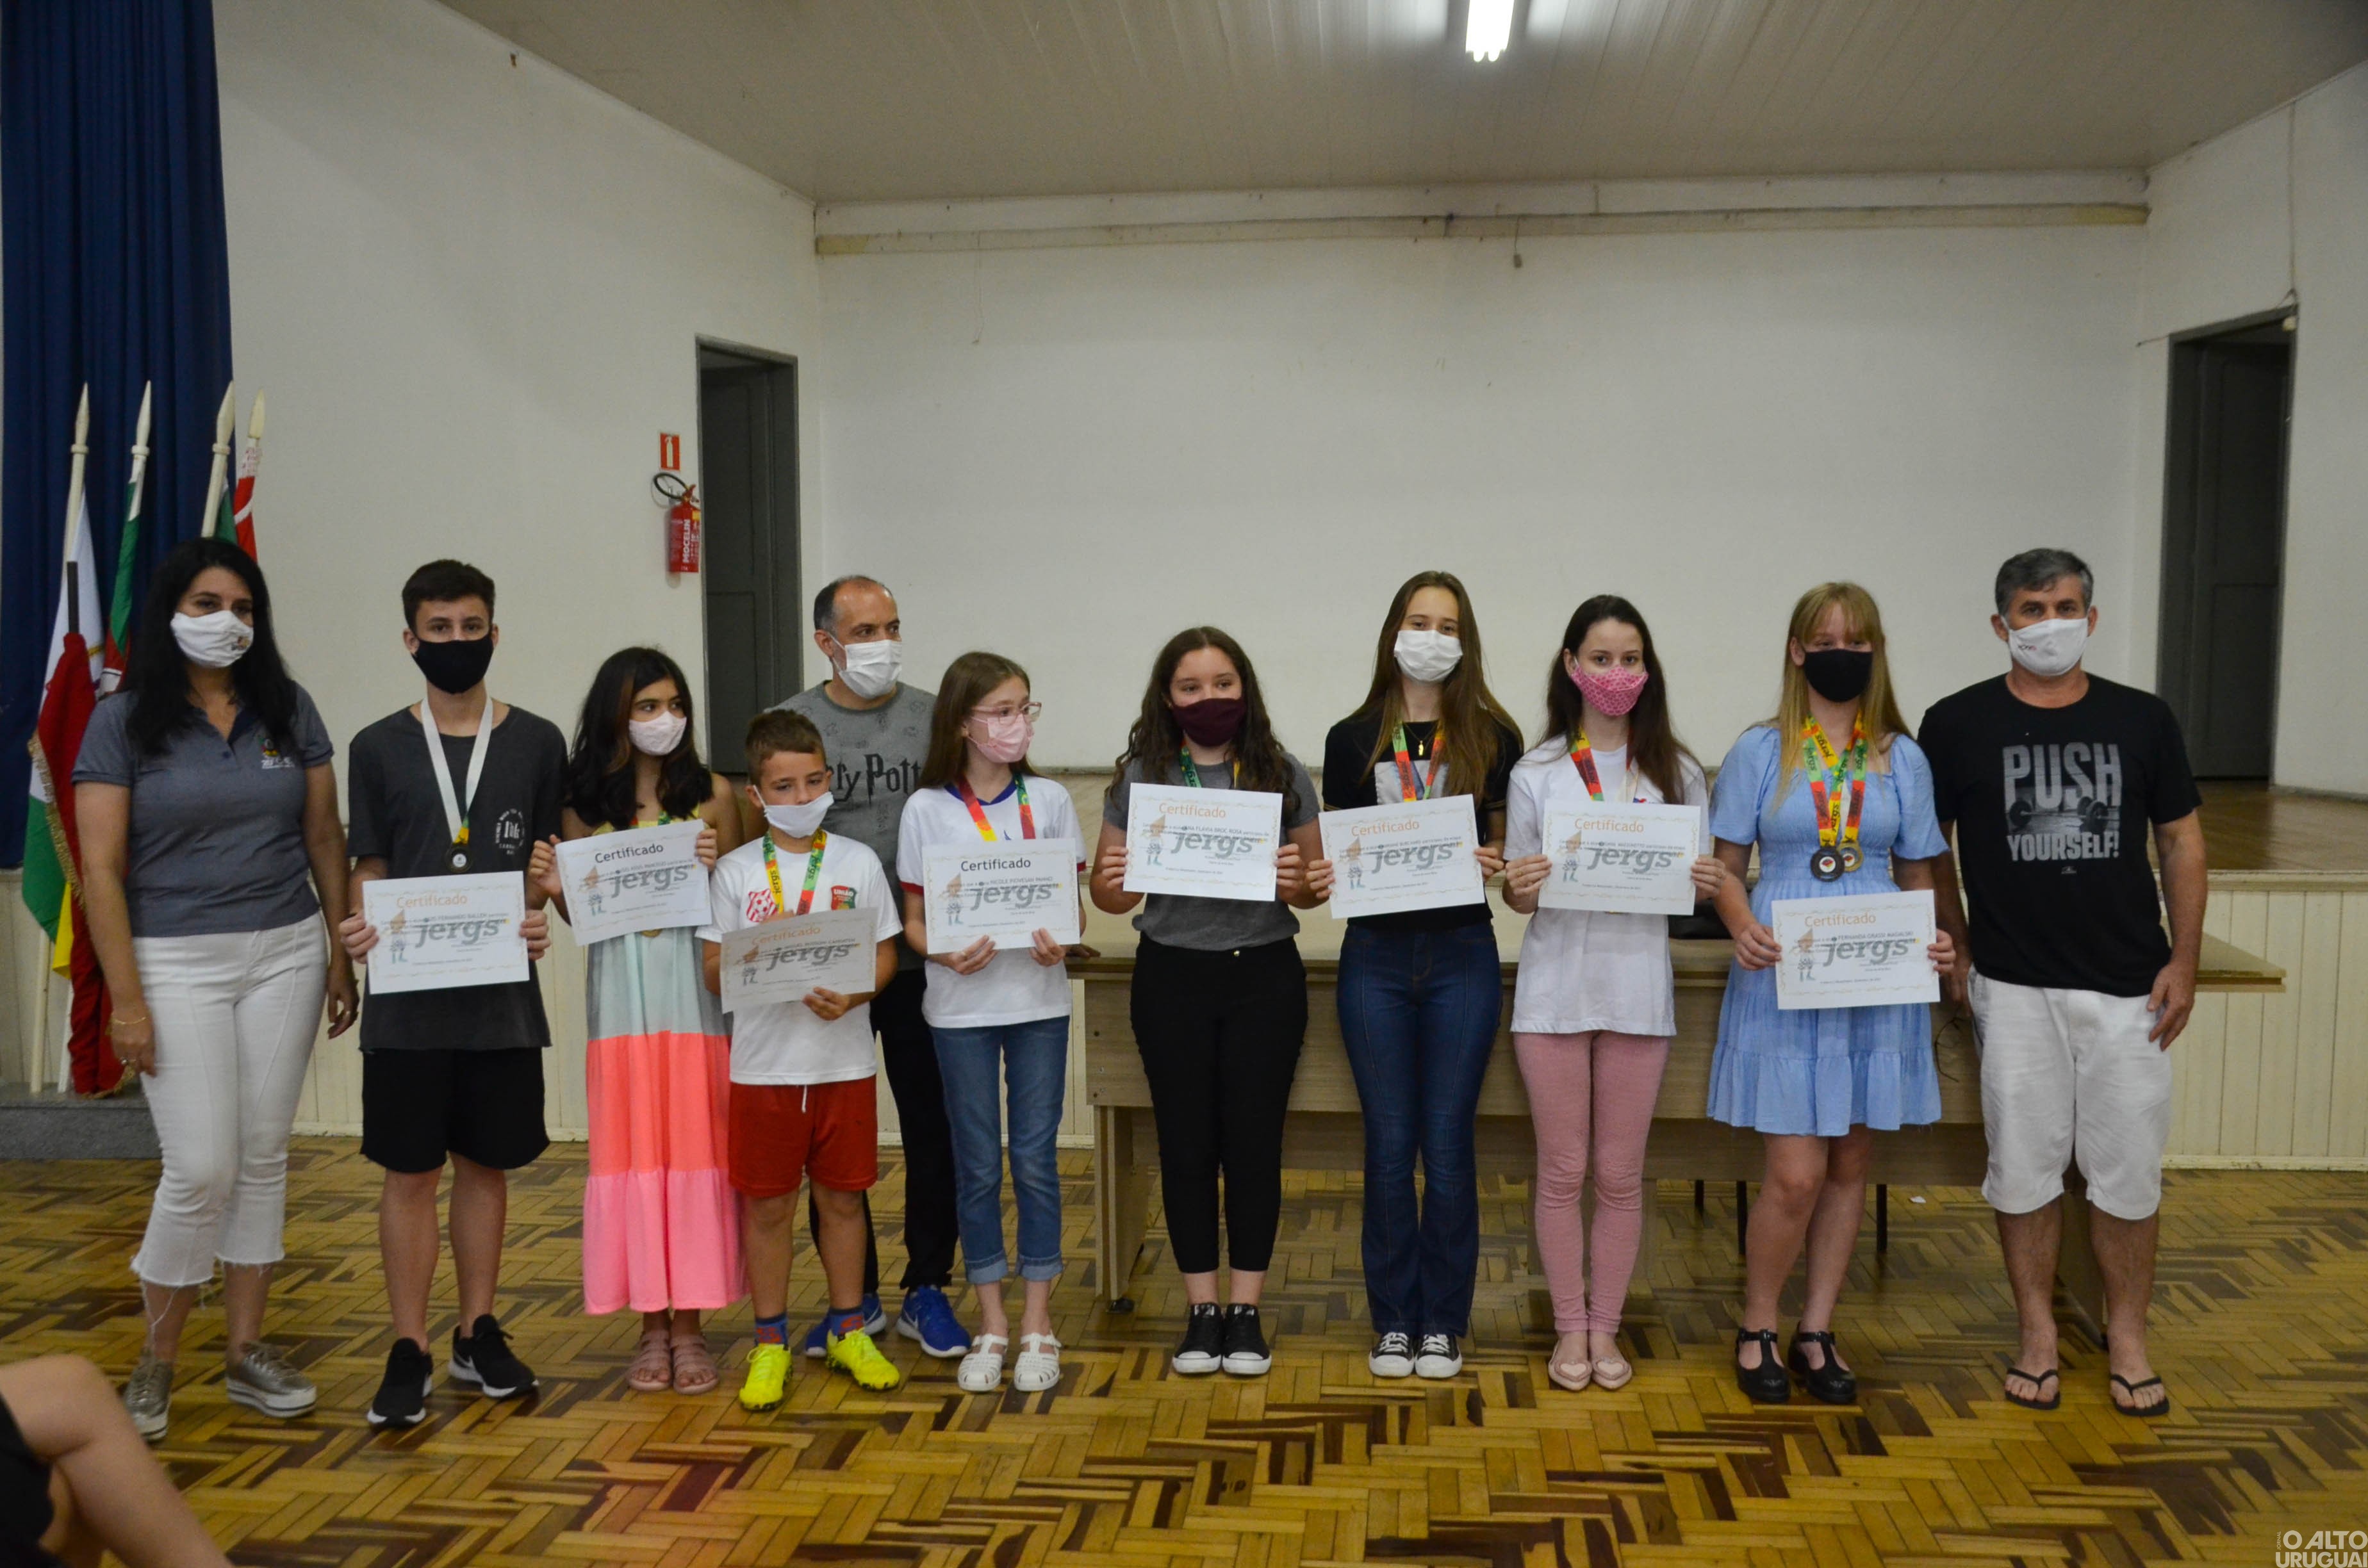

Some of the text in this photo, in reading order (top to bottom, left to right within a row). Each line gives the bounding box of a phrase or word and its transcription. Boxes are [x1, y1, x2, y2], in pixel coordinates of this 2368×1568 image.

[864, 753, 921, 808] Pott
[2002, 742, 2123, 813] PUSH
[1159, 803, 1226, 818] Certificado
[1575, 818, 1644, 833] Certificado
[1171, 826, 1253, 859] jergs
[1351, 820, 1420, 837] Certificado
[595, 844, 664, 863] Certificado
[1371, 844, 1452, 874] jergs
[1586, 842, 1672, 874] jergs
[2006, 830, 2119, 862] YOURSELF!
[961, 858, 1031, 872] Certificado
[609, 865, 689, 898] jergs
[969, 881, 1053, 911] jergs
[396, 894, 468, 908] Certificado
[413, 918, 500, 948] jergs
[752, 922, 821, 945] Certificado
[1804, 911, 1877, 927] Certificado
[766, 945, 851, 972] jergs
[1822, 936, 1909, 967] jergs
